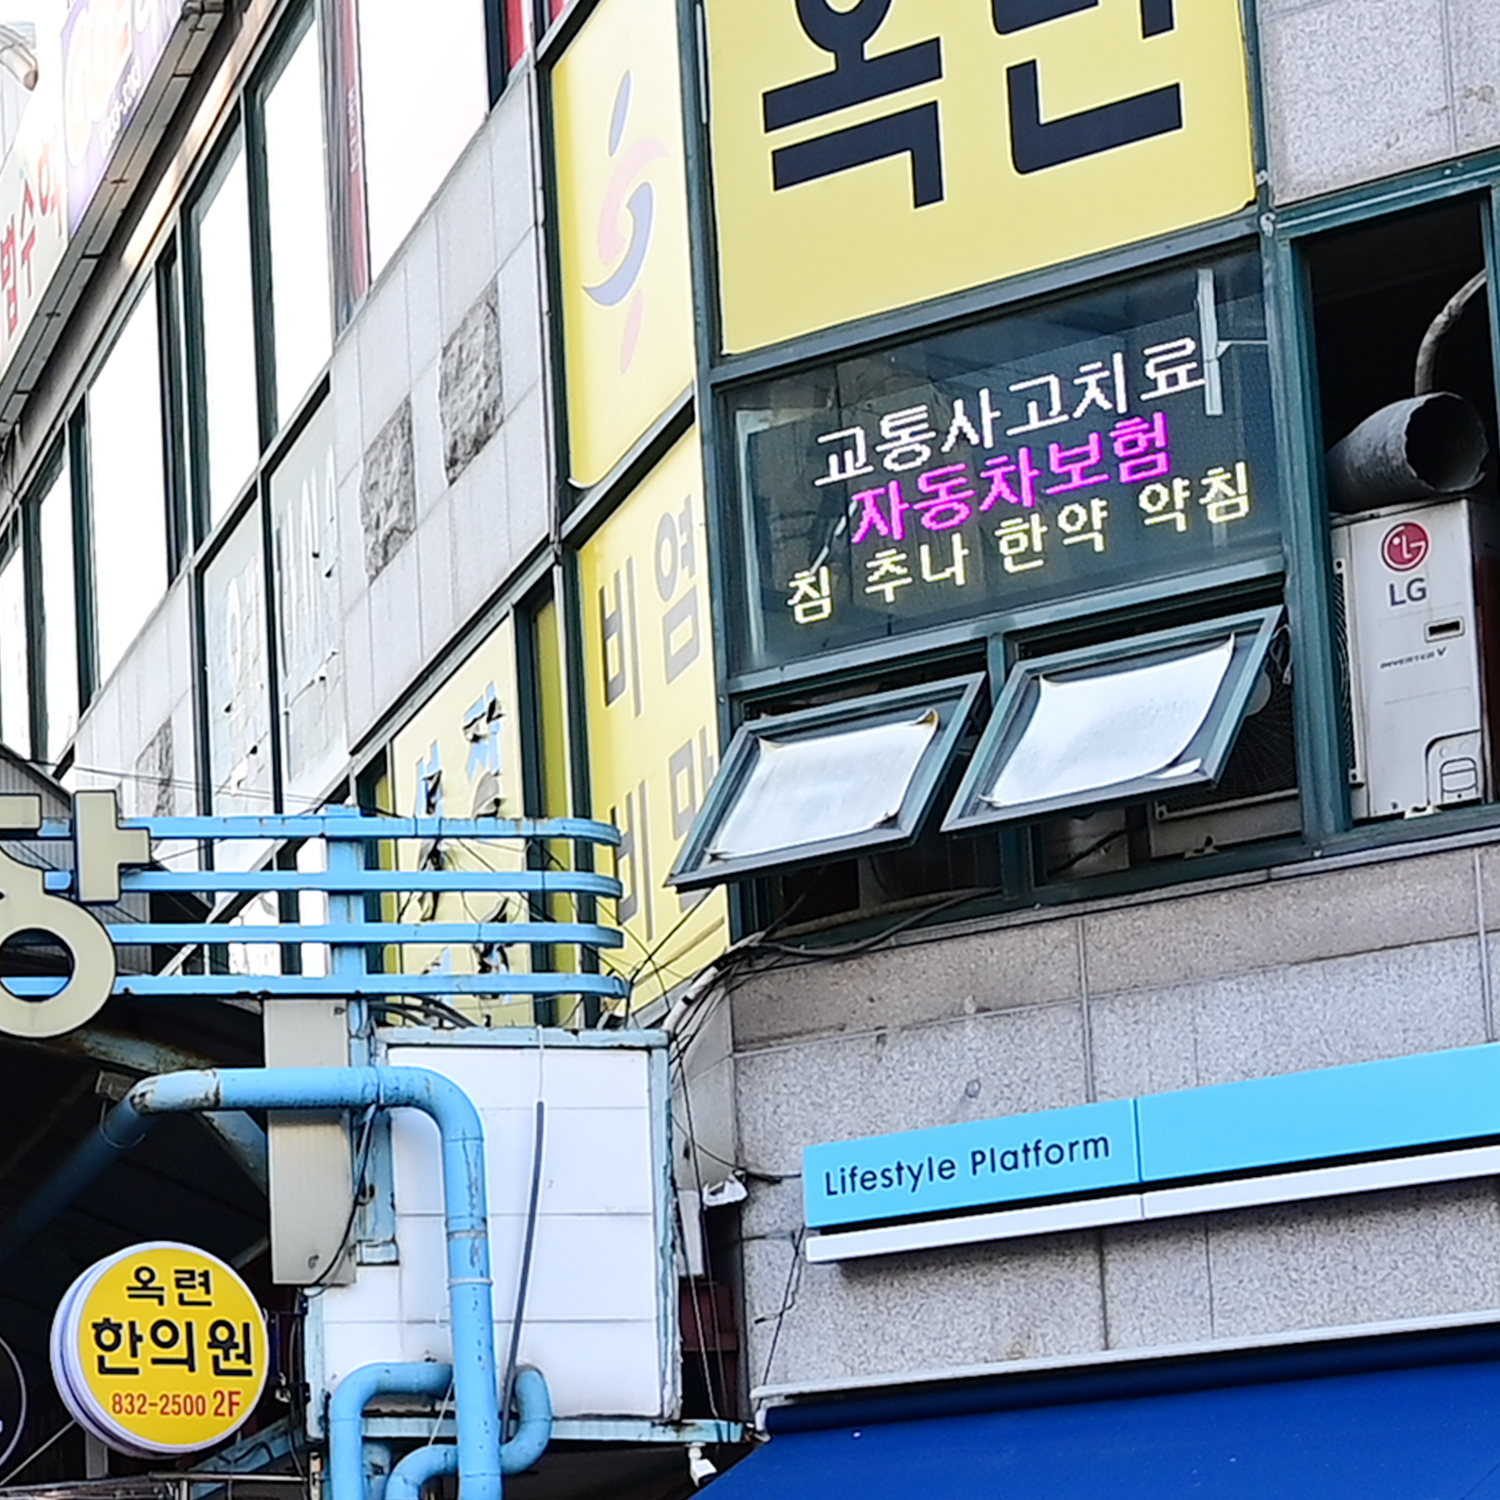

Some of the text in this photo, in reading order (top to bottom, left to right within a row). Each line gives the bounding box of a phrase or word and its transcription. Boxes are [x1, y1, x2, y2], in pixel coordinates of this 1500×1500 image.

[812, 336, 1205, 486] 교통사고치료
[850, 412, 1170, 545] 자동차보험
[786, 461, 1250, 624] 침 추나 한약 약침
[599, 494, 700, 717] 비염
[1389, 577, 1427, 605] LG
[825, 1132, 1110, 1197] Lifestyle Platform
[127, 1265, 214, 1307] 옥련
[91, 1316, 254, 1377] 한의원
[111, 1389, 241, 1418] 832-2500 2F
